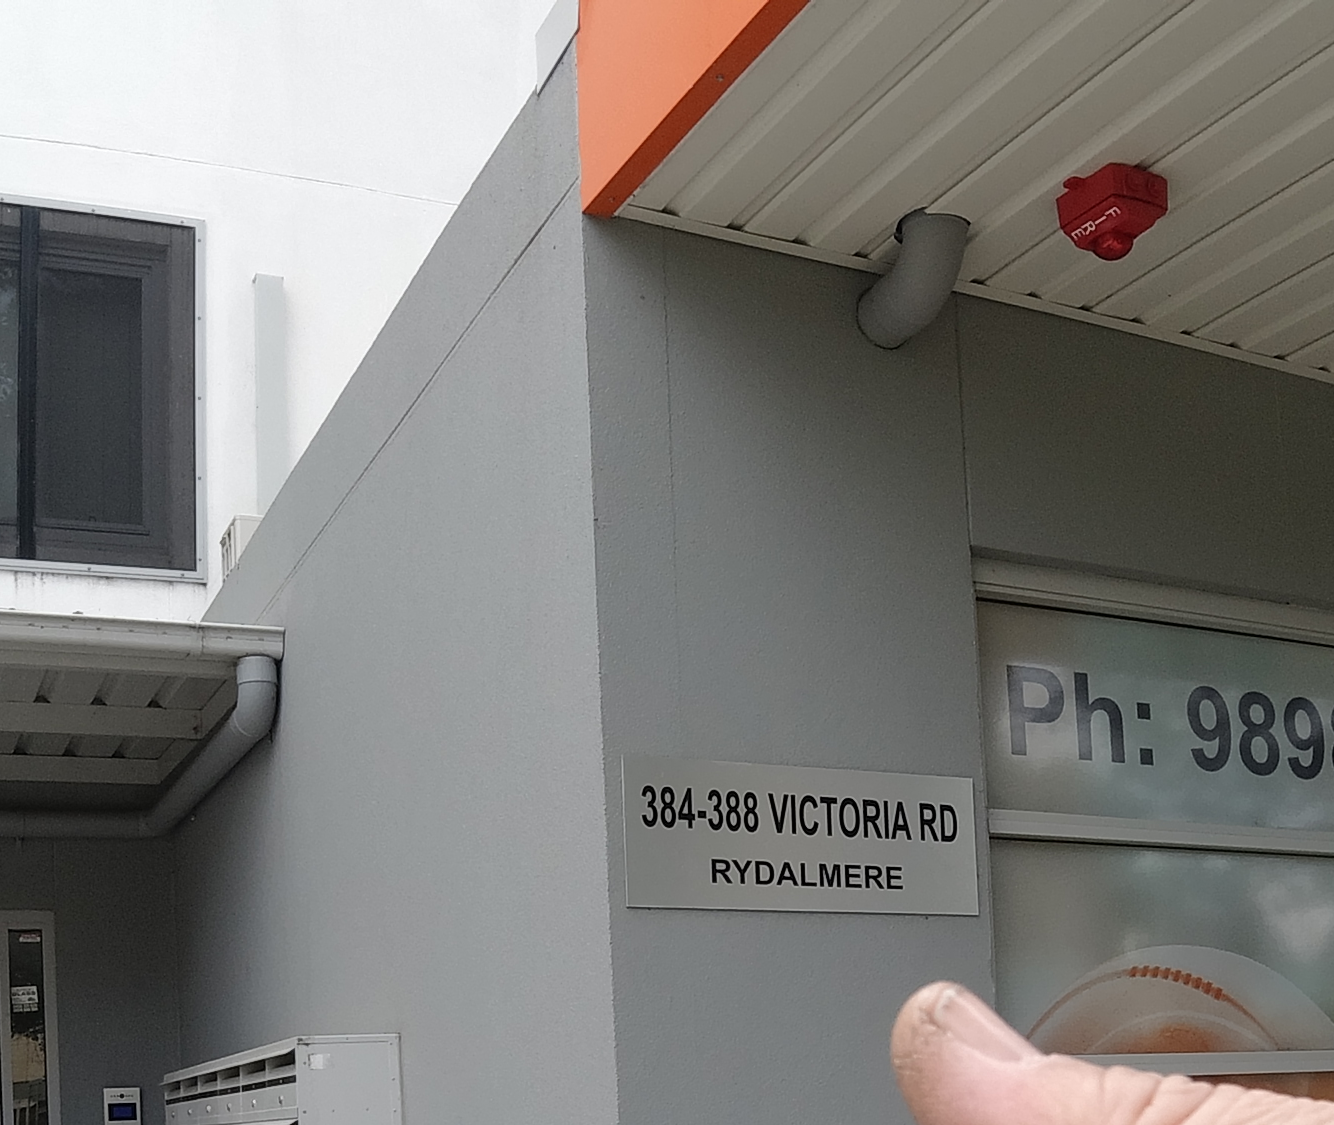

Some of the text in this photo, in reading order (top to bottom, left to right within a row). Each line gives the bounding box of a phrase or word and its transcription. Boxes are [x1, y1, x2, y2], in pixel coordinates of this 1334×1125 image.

[1071, 206, 1122, 241] FIRE
[1005, 664, 1155, 767] Ph:
[640, 784, 958, 843] 384-388 VICTORIA RD
[710, 858, 904, 891] RYDALMERE
